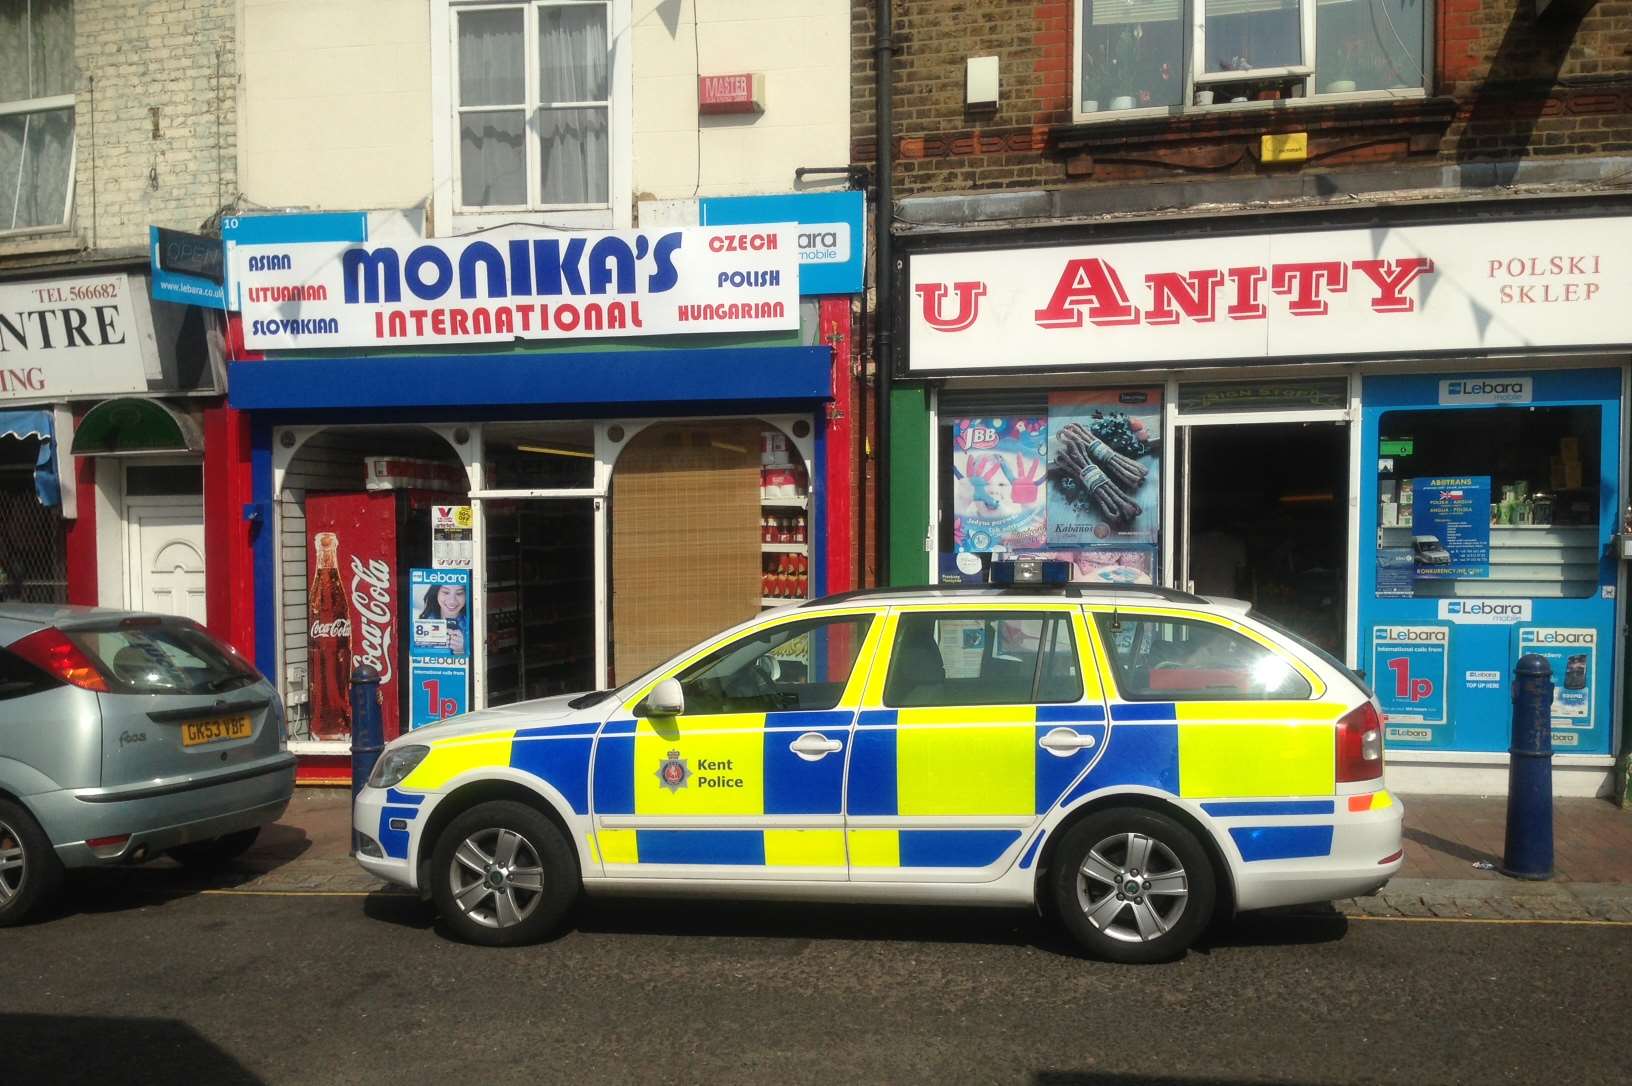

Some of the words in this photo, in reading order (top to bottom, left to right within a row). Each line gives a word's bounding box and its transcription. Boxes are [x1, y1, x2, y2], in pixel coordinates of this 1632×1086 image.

[705, 76, 747, 97] MASTER
[224, 219, 239, 229] 10
[708, 233, 778, 253] CZECH
[798, 232, 837, 248] ara
[248, 254, 292, 272] ASIAN
[343, 231, 683, 304] MONIKA'S
[1487, 255, 1601, 279] POLSKI
[717, 269, 781, 289] POLISH
[69, 283, 117, 302] 566682
[160, 280, 225, 299] www.lebara.co.uk
[248, 285, 328, 303] LITUANIAN
[1034, 256, 1435, 329] ANITY
[1499, 281, 1601, 305] SKLEP
[677, 300, 785, 323] HUNGARIAN
[915, 280, 988, 332] U
[252, 318, 339, 336] SLOVAKIAN
[375, 300, 643, 338] INTERNATIONAL
[0, 367, 46, 393] ING
[1462, 382, 1523, 395] Lebara
[964, 427, 996, 449] JBB
[1054, 523, 1093, 533] Kabanos
[423, 571, 467, 583] Lebara
[1462, 601, 1522, 615] Lebara
[415, 624, 430, 637] 8p
[1389, 628, 1446, 641] Lebara
[1535, 630, 1594, 643] Lebara
[423, 657, 467, 665] Lebara
[1387, 656, 1434, 703] 1p
[422, 679, 458, 721] 1p
[188, 720, 222, 741] GK53
[224, 716, 245, 736] VBF
[1397, 728, 1428, 737] Lebara
[1553, 733, 1575, 742] bara
[698, 759, 734, 771] Kent
[698, 776, 744, 788] Police
